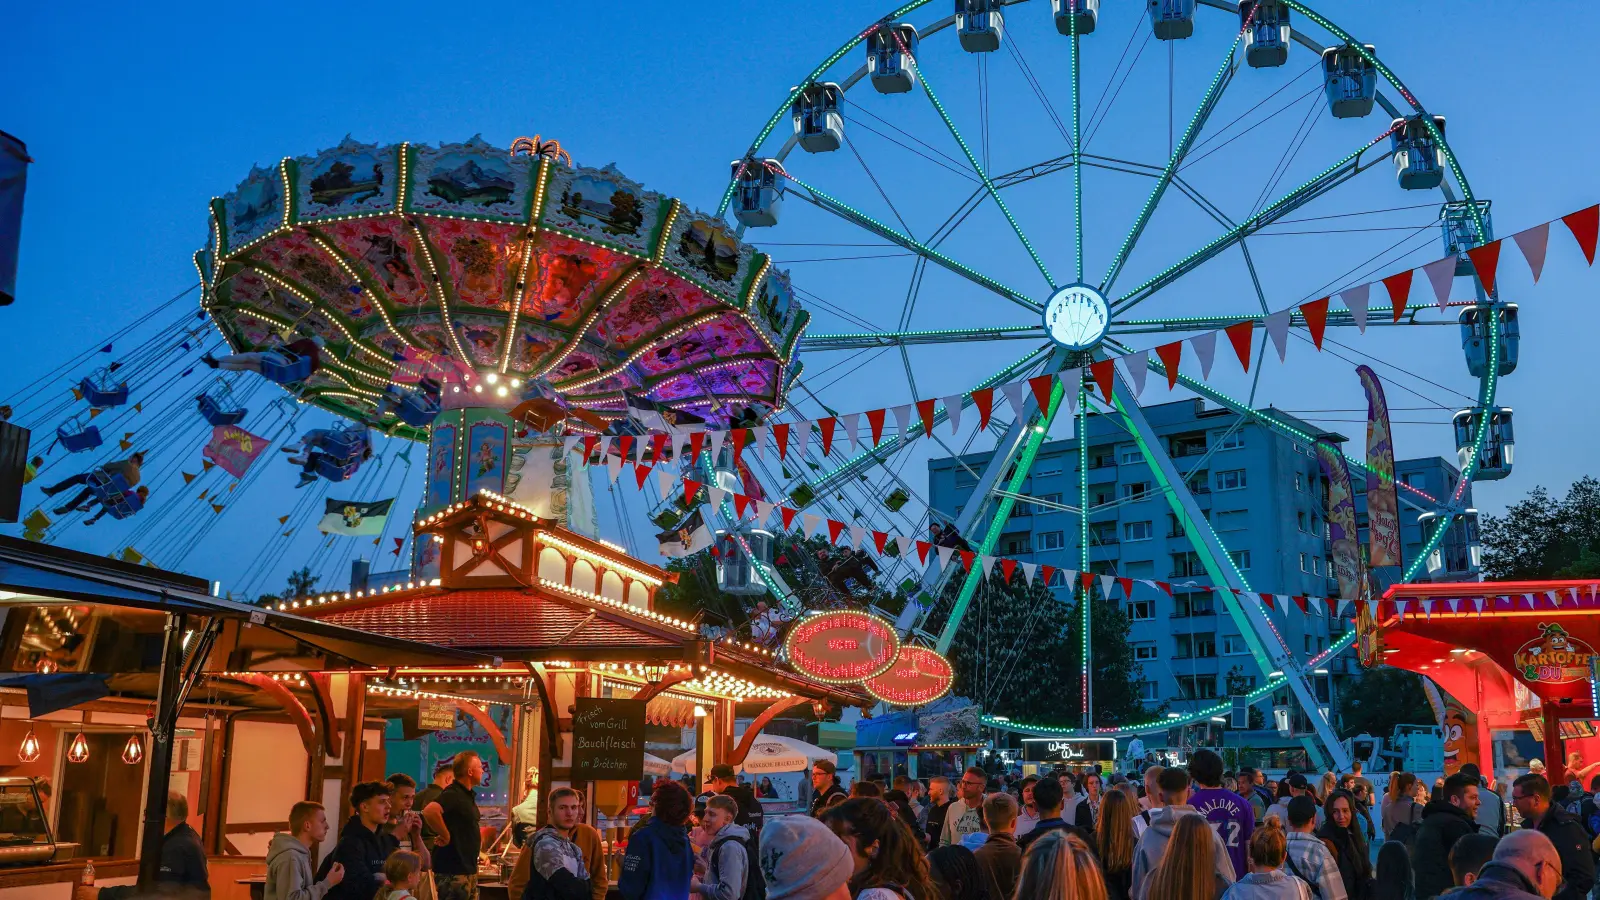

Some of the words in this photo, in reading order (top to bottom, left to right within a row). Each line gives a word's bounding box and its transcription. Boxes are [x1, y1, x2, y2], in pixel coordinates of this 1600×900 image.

[797, 614, 889, 643] Spezialitäten
[828, 639, 858, 650] vom
[793, 643, 893, 678] Holzkohlegrill
[899, 647, 944, 672] alitäten
[895, 669, 919, 679] vom
[606, 717, 628, 730] Grill
[578, 736, 636, 751] Bauchfleisch
[1197, 798, 1240, 818] MALONE
